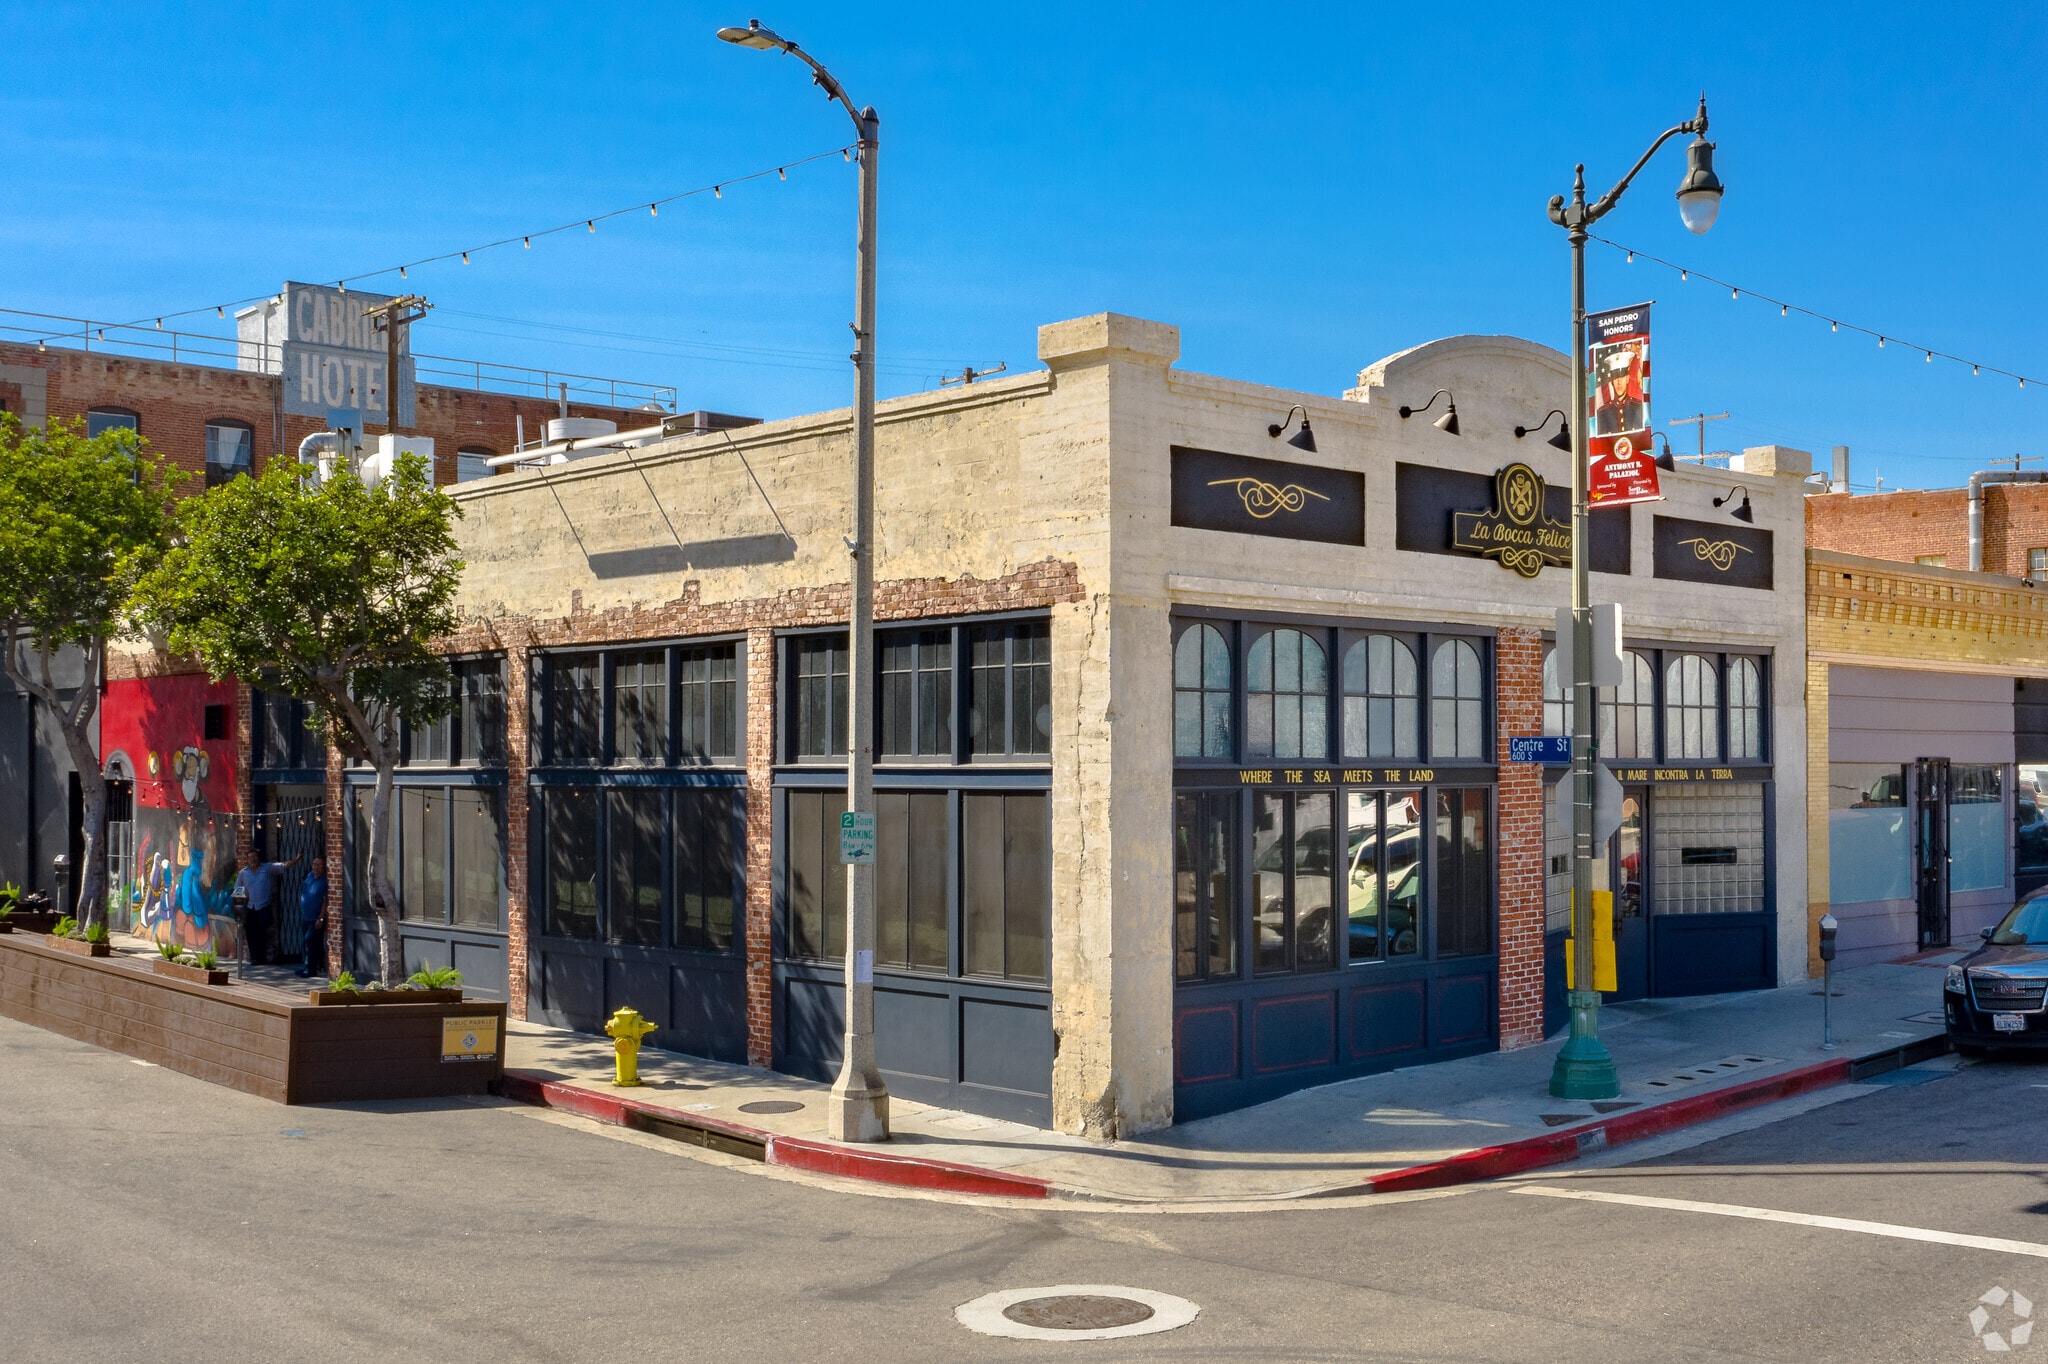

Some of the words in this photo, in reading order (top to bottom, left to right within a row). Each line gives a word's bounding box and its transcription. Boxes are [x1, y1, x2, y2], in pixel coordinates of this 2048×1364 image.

[1598, 317, 1614, 328] SAN
[1614, 312, 1639, 325] PEDRO
[1603, 323, 1634, 336] HONORS
[300, 352, 389, 411] HOTE
[1605, 462, 1635, 472] ANTHONY
[1469, 521, 1491, 540] La
[1493, 523, 1534, 545] Bocca
[1535, 527, 1572, 549] Felice
[1512, 738, 1544, 752] Centre
[1556, 738, 1568, 752] St
[1512, 751, 1526, 761] 600
[1527, 751, 1533, 761] S
[1239, 770, 1273, 784] WHERE
[1284, 770, 1303, 783] THE
[1313, 770, 1331, 783] SEA
[1342, 769, 1373, 783] MEETS
[1384, 769, 1401, 782] THE
[1409, 769, 1434, 782] LAND
[1627, 769, 1648, 781] MARE
[1654, 769, 1689, 780] INCONTRA
[1695, 769, 1705, 780] LA
[1711, 768, 1733, 780] TERRA
[843, 814, 852, 826] 2
[855, 817, 873, 826] HOUR
[843, 829, 873, 839] PARKING
[1992, 986, 2026, 994] GMC
